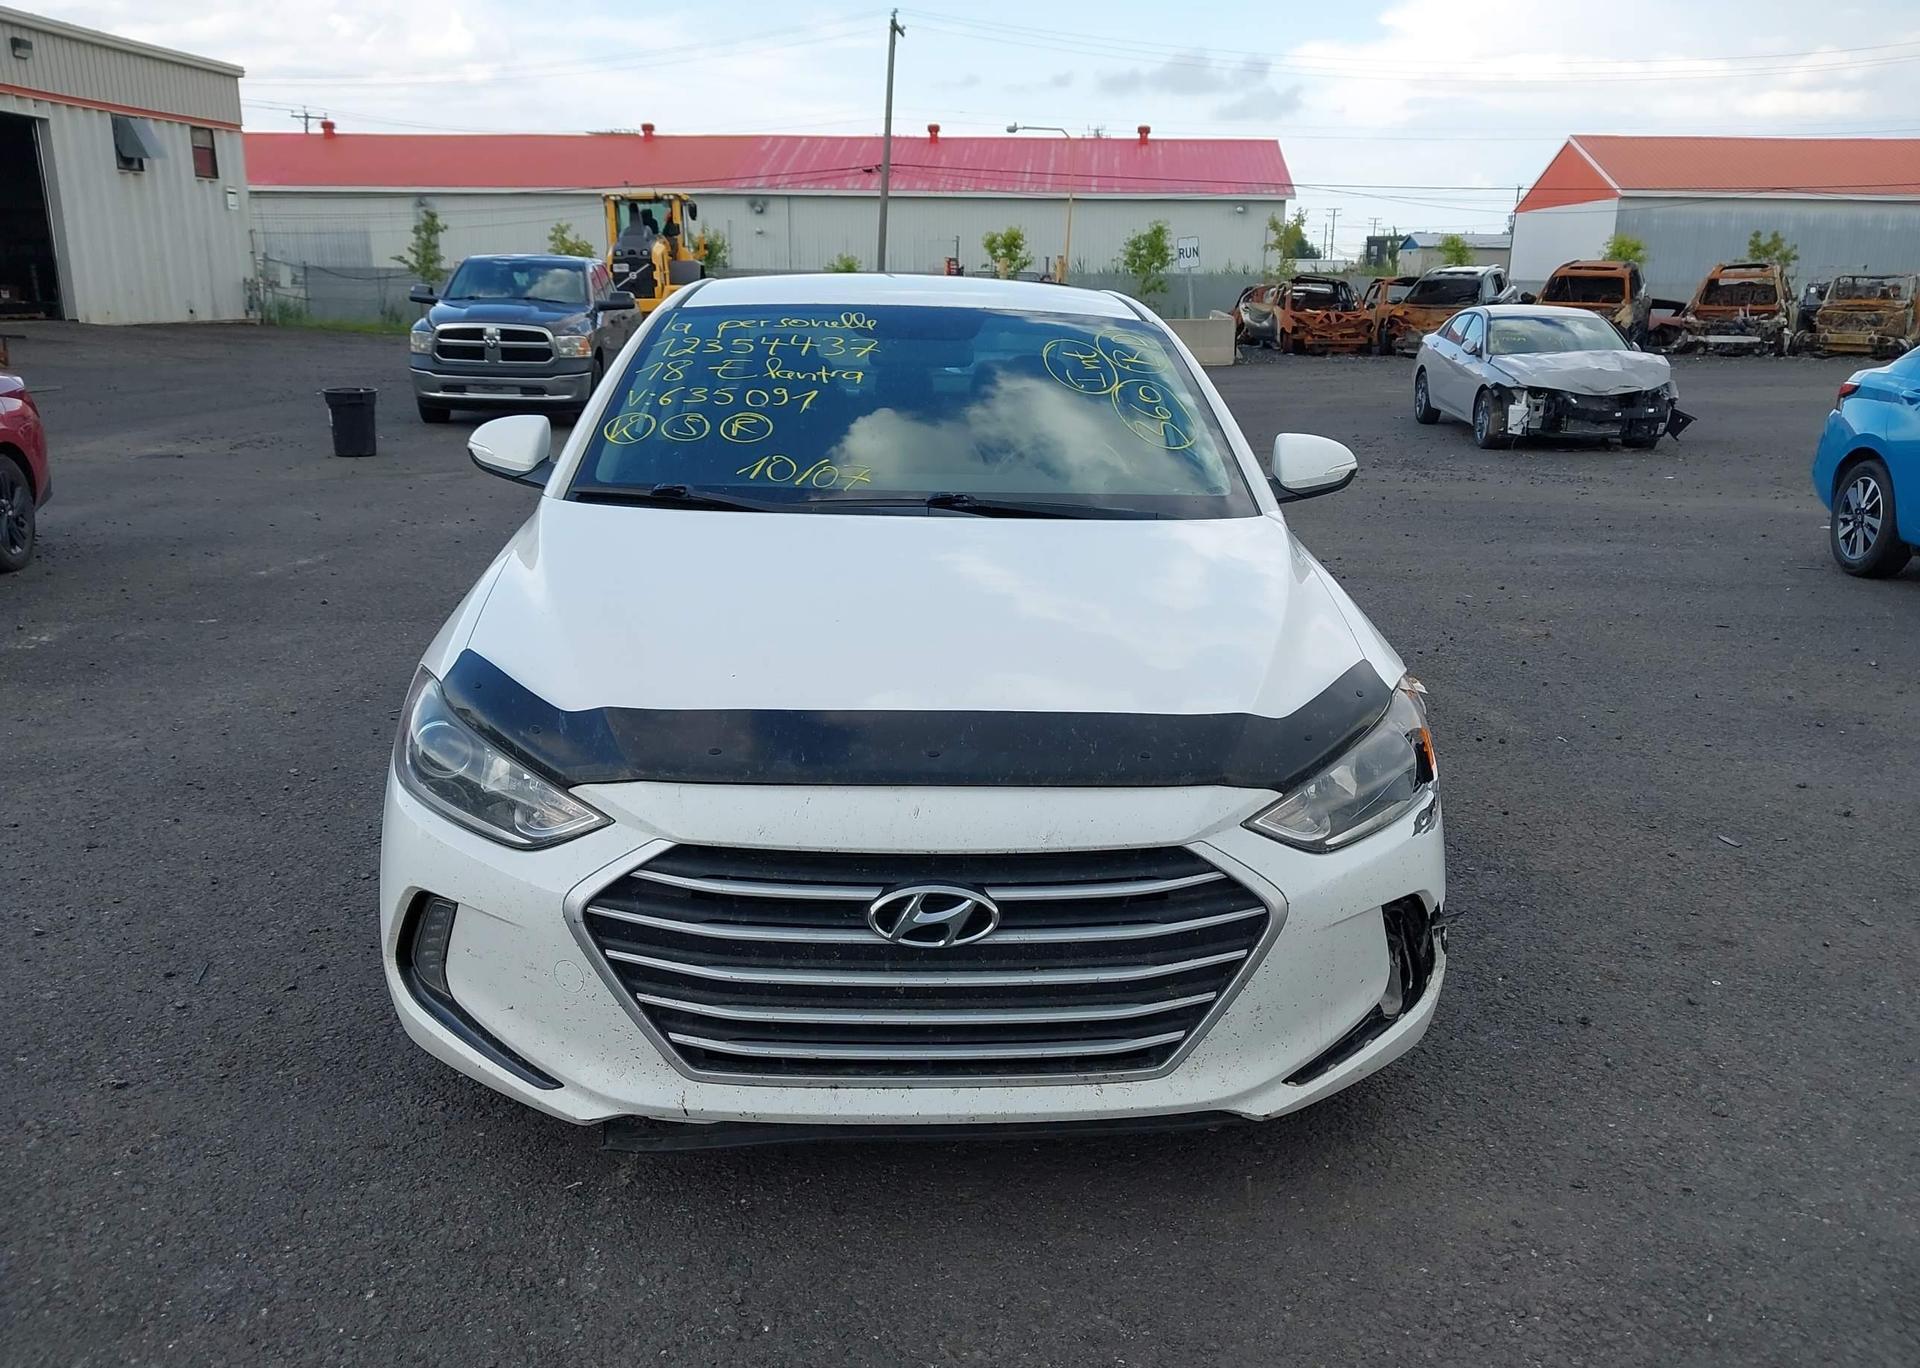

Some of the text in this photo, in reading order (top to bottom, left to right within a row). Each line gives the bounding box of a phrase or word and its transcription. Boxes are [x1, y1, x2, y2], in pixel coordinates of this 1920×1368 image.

[1178, 246, 1199, 260] RUN
[651, 334, 882, 358] 12354437
[635, 359, 695, 382] 18
[735, 454, 873, 492] 10/07
